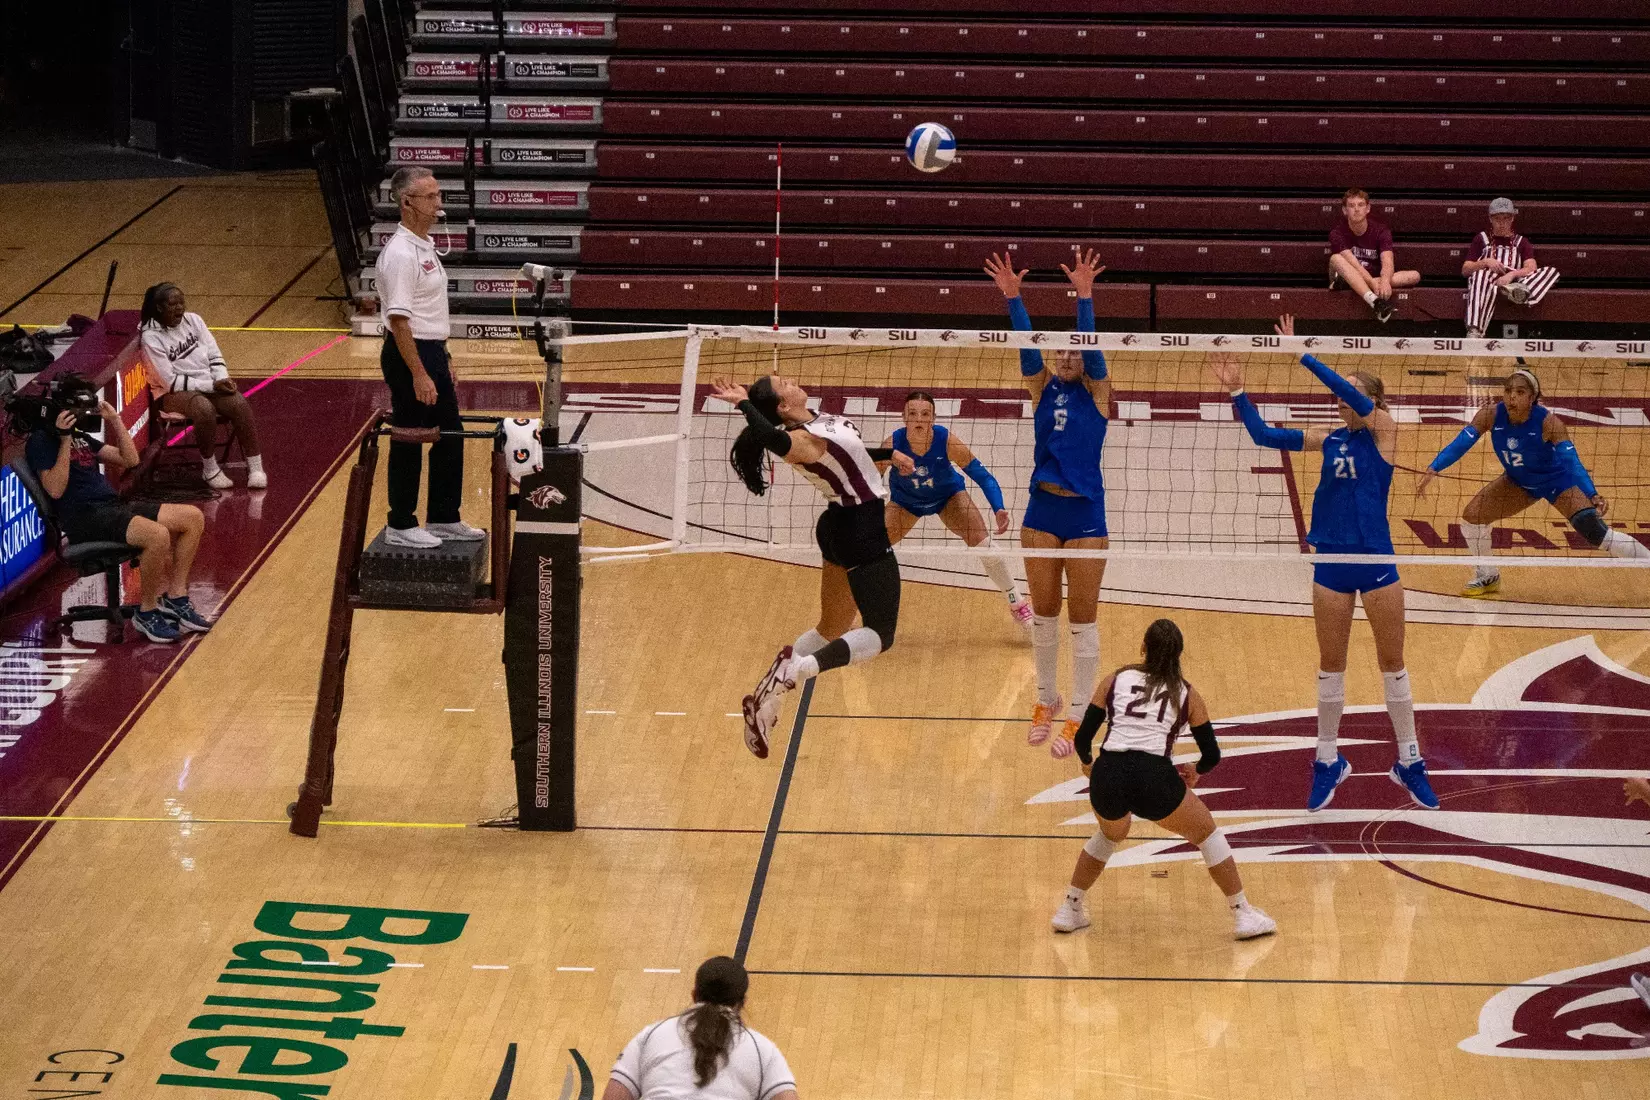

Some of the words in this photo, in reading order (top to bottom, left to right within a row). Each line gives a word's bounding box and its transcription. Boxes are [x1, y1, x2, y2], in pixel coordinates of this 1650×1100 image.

[798, 329, 826, 339] SIU
[889, 330, 916, 341] SIU
[979, 332, 1007, 342] SIU
[1070, 334, 1098, 345] SIU
[1160, 336, 1189, 346] SIU
[1252, 337, 1280, 347] SIU
[1343, 338, 1371, 349] SIU
[1434, 340, 1462, 350] SIU
[1525, 341, 1553, 352] SIU
[1616, 343, 1645, 353] SIU
[561, 393, 1648, 426] SUHERN
[1501, 450, 1524, 467] 12
[1333, 456, 1358, 480] 21
[911, 478, 934, 489] 14
[0, 506, 43, 565] SURANCE
[538, 556, 553, 650] UNIVERSITY
[538, 653, 552, 719] ILLINOIS
[1124, 685, 1173, 723] 21
[535, 722, 551, 808] SOUTHERN
